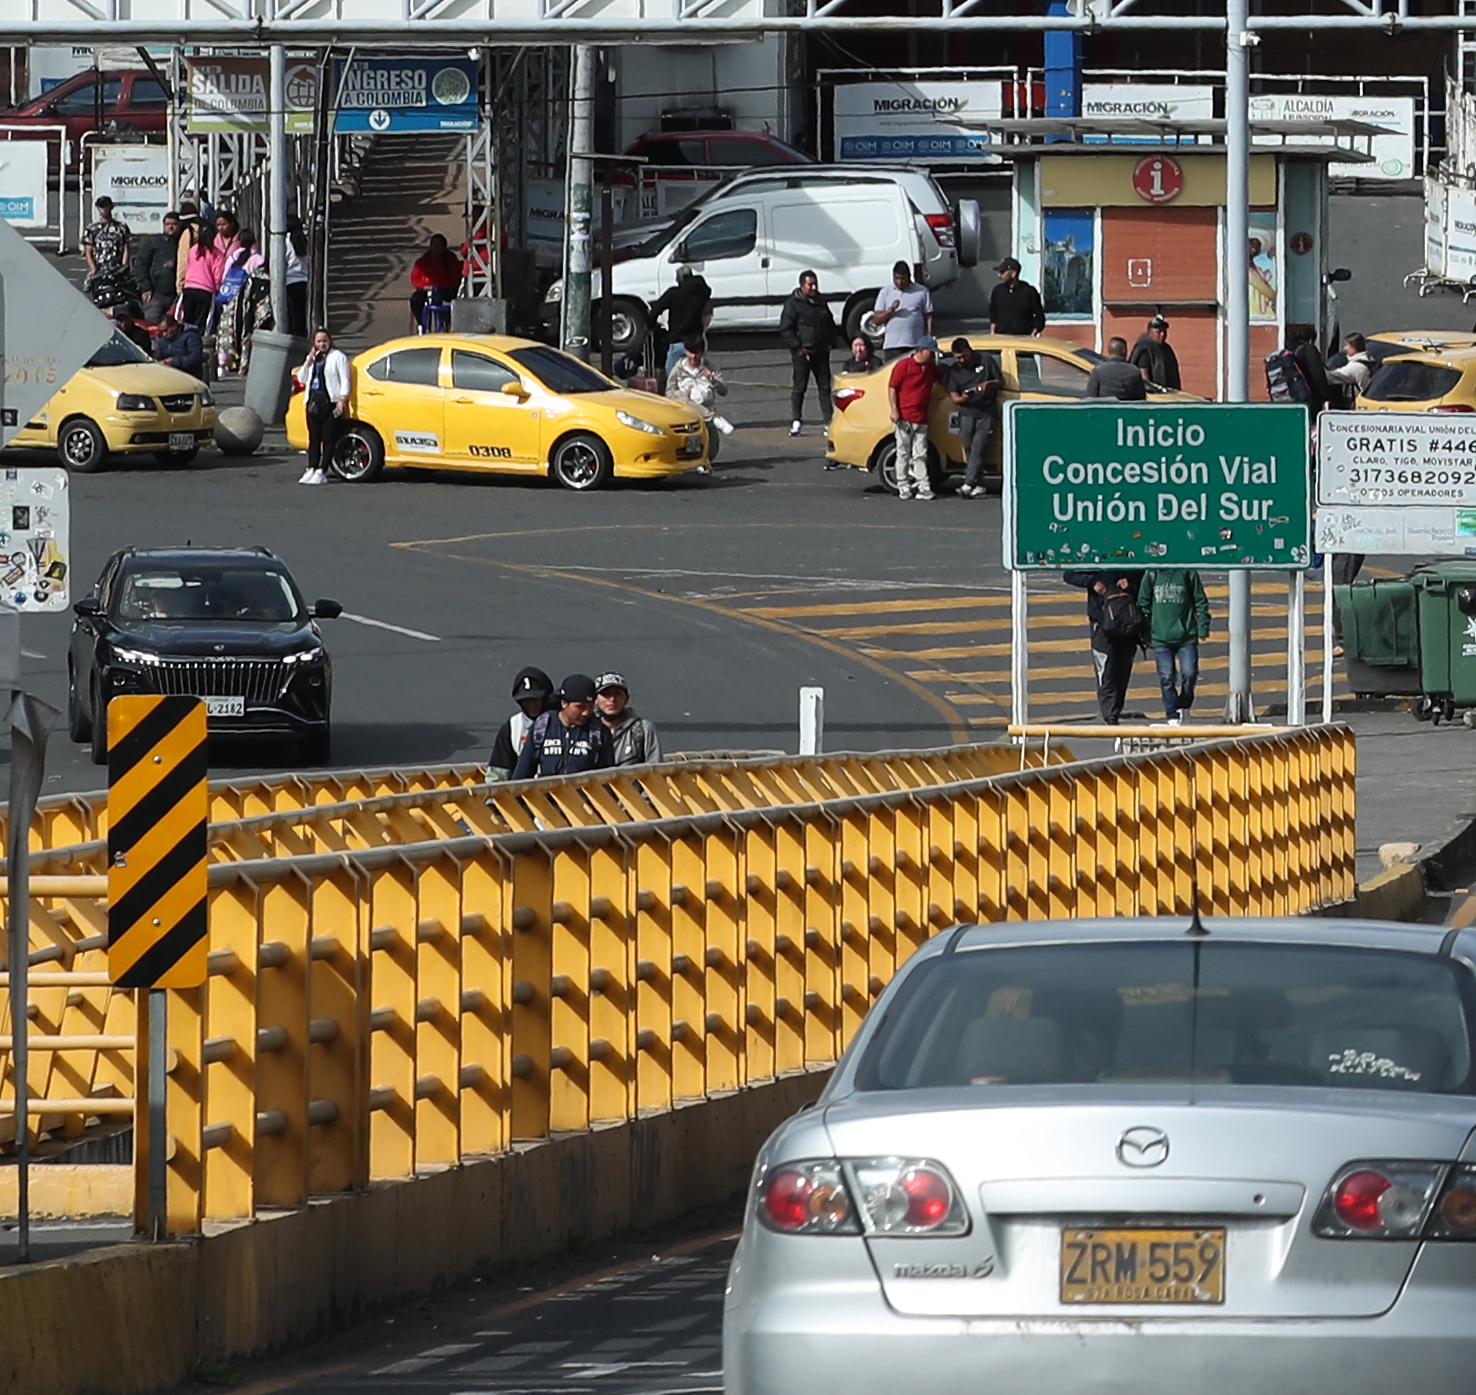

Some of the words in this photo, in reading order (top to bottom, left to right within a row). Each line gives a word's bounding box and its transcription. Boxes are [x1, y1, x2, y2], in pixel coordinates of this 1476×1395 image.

[192, 73, 266, 96] SALIDA
[343, 68, 427, 91] INGRESO
[210, 98, 265, 111] COLOMBIA
[357, 90, 424, 107] COLOMBIA
[874, 96, 959, 113] MIGRACIÓN
[1283, 97, 1334, 114] ALCALDÍA
[1086, 100, 1169, 115] MIGRACIÓN
[111, 174, 167, 187] MIGRACIÓ
[1117, 418, 1206, 447] Inicio
[1329, 421, 1404, 434] CONCESIONARIA
[1406, 424, 1427, 434] VIAL
[1429, 424, 1457, 435] UNIÓN
[1458, 426, 1476, 435] DEL
[469, 444, 512, 459] 0308
[1346, 437, 1418, 453] GRATIS
[1042, 455, 1209, 485] Concesión
[1219, 455, 1277, 485] Vial
[1423, 457, 1473, 467] MOVISTAR
[1349, 468, 1476, 485] 3173682092
[1397, 488, 1464, 498] OPERADORES
[1053, 493, 1147, 522] Unión
[1158, 493, 1208, 522] Del
[1218, 492, 1275, 522] Sur
